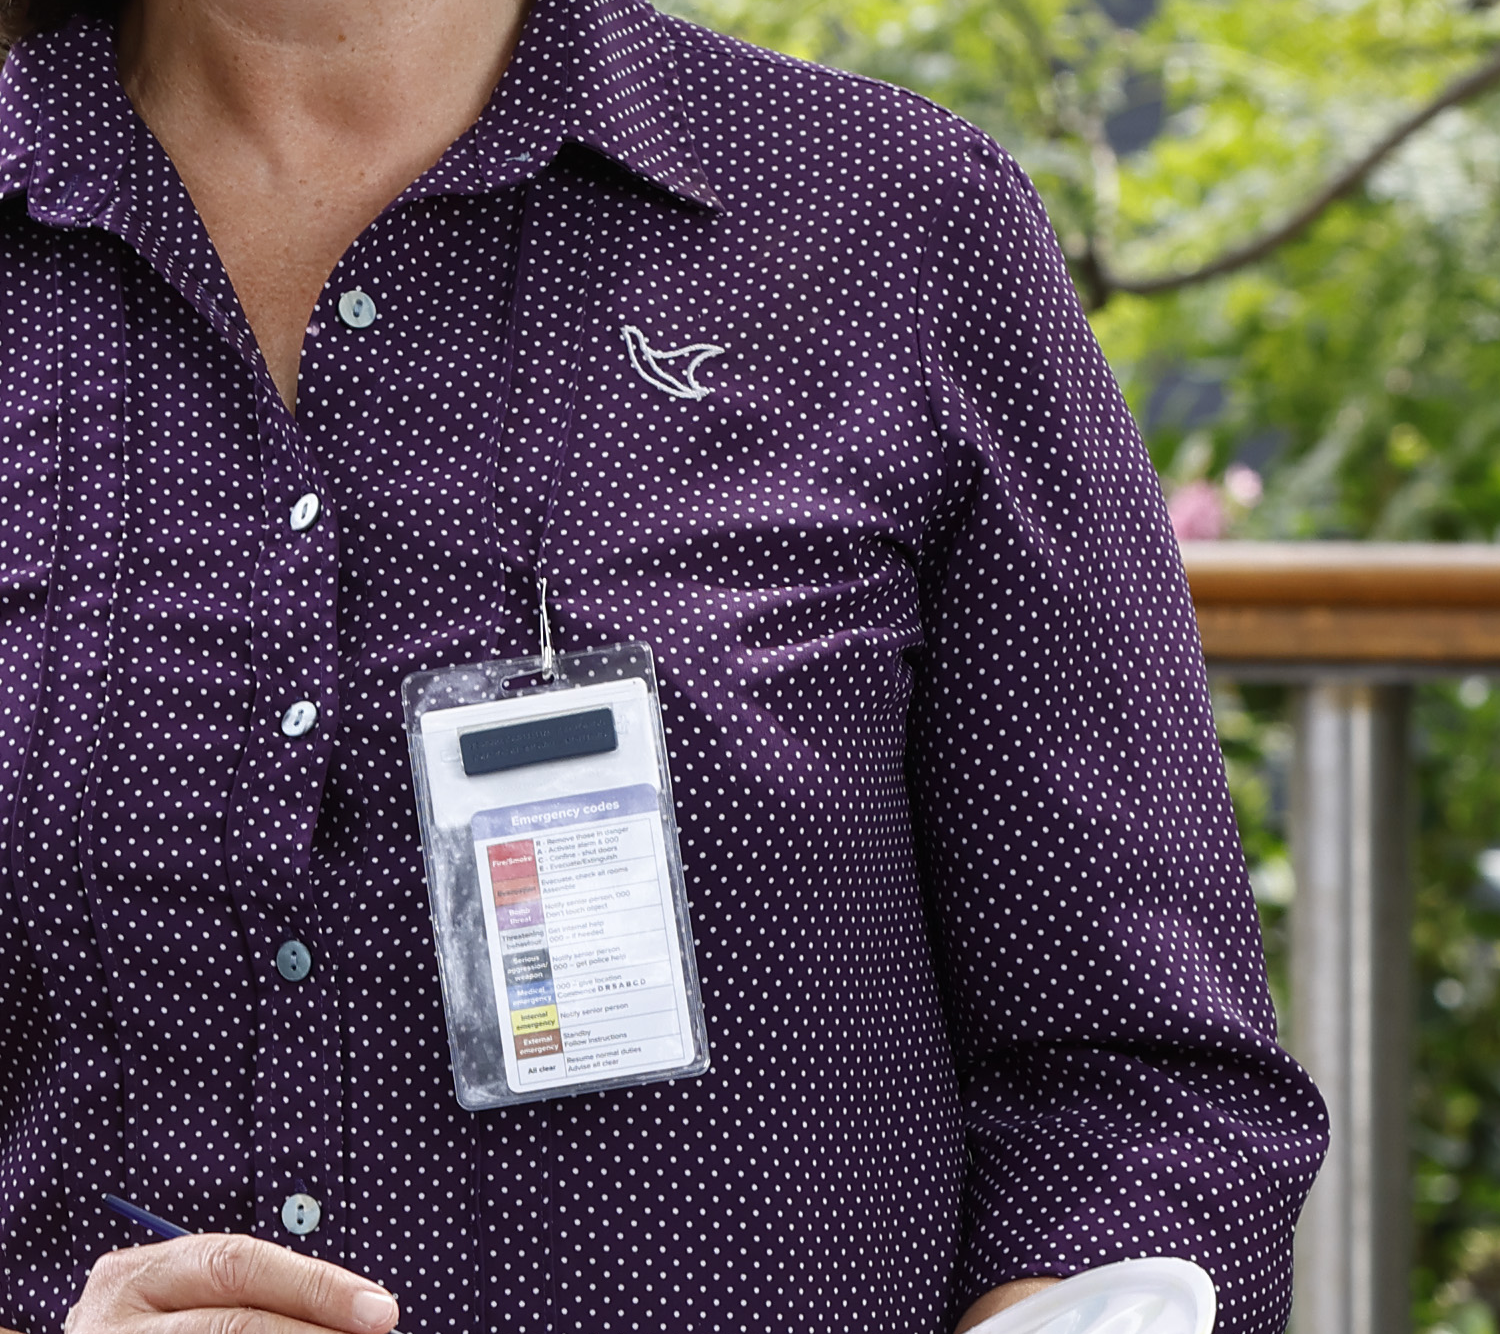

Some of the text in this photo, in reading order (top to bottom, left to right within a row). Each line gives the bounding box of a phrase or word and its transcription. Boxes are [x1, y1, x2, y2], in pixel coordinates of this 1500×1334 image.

[511, 801, 620, 827] Emergency codes
[547, 836, 574, 845] Remove
[576, 832, 595, 840] those
[604, 827, 628, 835] danger
[548, 844, 576, 853] Activate
[604, 836, 619, 844] 000
[550, 853, 576, 862] Confine
[598, 846, 617, 854] doors
[492, 854, 533, 867] Fire/Smoke
[550, 854, 618, 870] Evacuate/Extinguish
[575, 871, 596, 879] check
[607, 866, 628, 874] rooms
[543, 884, 575, 894] Assemble
[545, 902, 564, 910] Notify
[566, 898, 587, 906] senior
[615, 890, 630, 898] 000
[508, 908, 531, 916] Bomb
[566, 907, 585, 915] touch
[587, 903, 608, 912] object
[510, 916, 532, 924] threat
[502, 930, 544, 942] Threatening
[549, 935, 564, 943] 000
[577, 928, 604, 937] needed
[507, 940, 542, 949] behaviour
[512, 956, 540, 964] Serious
[552, 946, 620, 963] Notify senior person
[507, 961, 548, 975] aggression/
[553, 962, 568, 971] 000
[588, 956, 609, 966] police
[610, 953, 626, 961] help
[514, 972, 543, 982] weapon
[556, 982, 570, 990] 000
[578, 980, 593, 988] give
[594, 974, 622, 983] location
[517, 987, 545, 996] Medical
[557, 987, 596, 998] Commence
[512, 995, 552, 1006] emergency
[521, 1011, 548, 1021] Internal
[560, 1003, 628, 1019] Notify senior person
[516, 1019, 555, 1030] emergency
[563, 1029, 591, 1039] Standby
[564, 1032, 627, 1047] Follow instructions
[523, 1035, 552, 1046] External
[519, 1044, 559, 1055] emergency
[566, 1046, 641, 1063] Resume normal duties
[528, 1064, 556, 1074] All clear
[568, 1063, 591, 1072] Advise
[602, 1058, 619, 1066] clear
